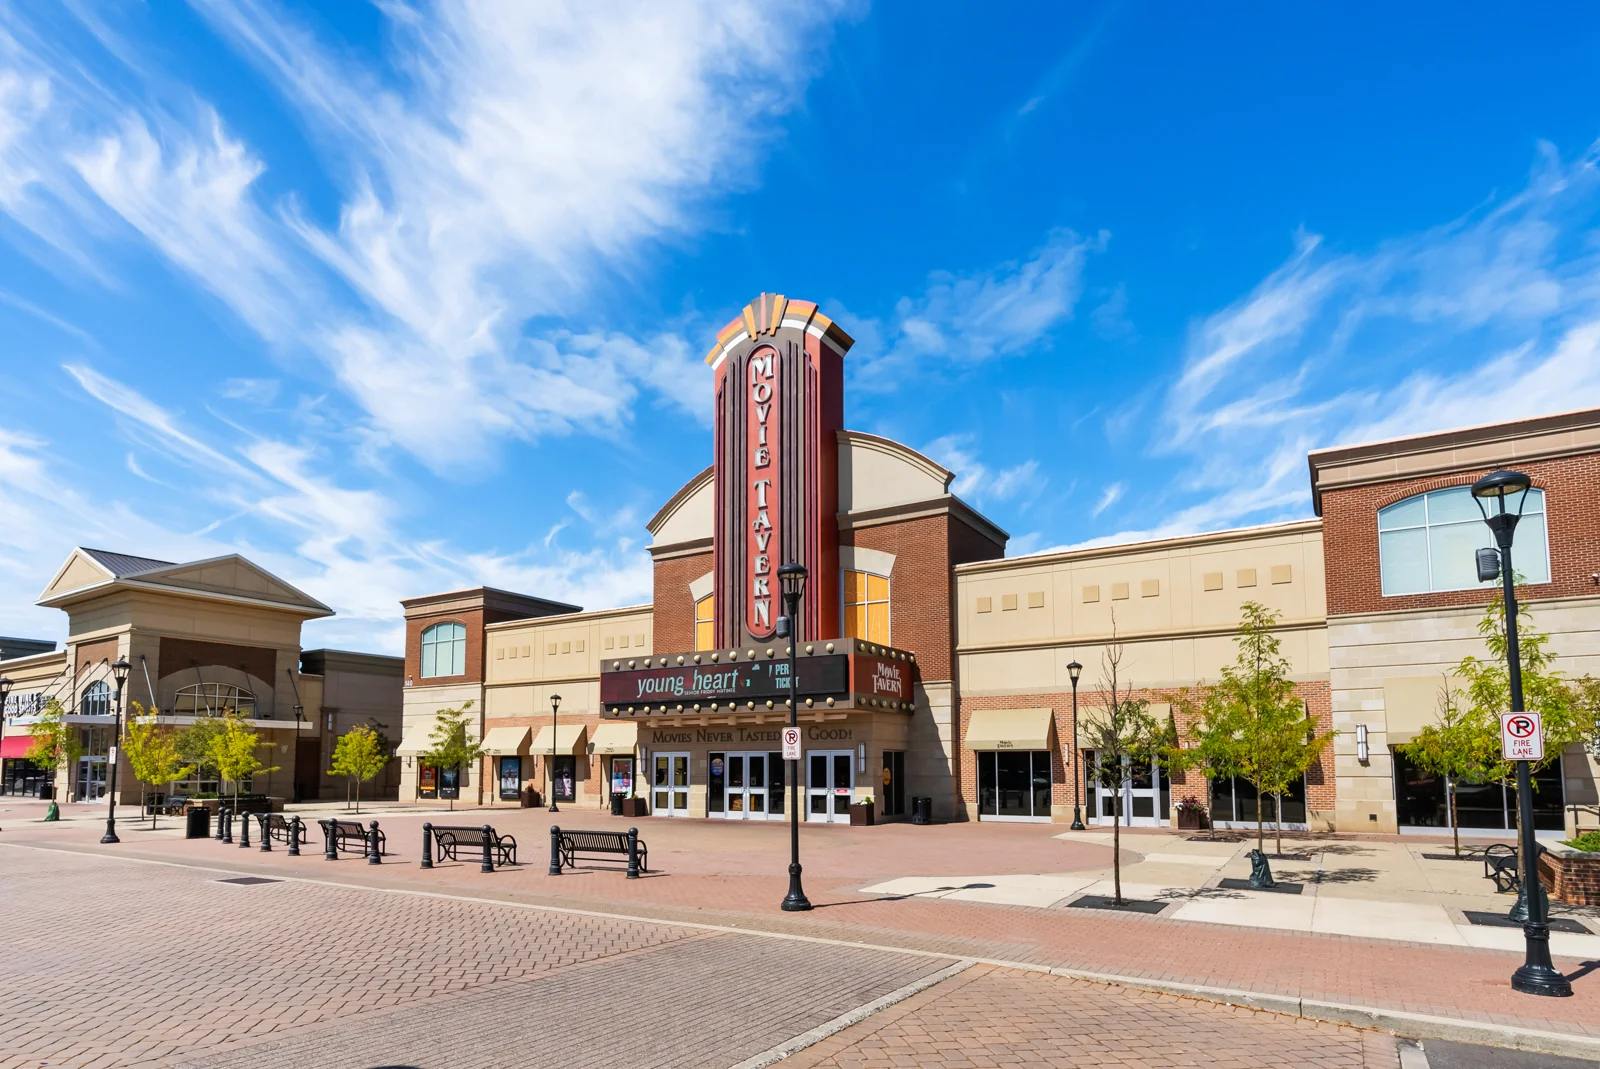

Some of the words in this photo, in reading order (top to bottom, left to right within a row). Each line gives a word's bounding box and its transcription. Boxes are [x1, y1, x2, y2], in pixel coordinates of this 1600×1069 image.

[752, 354, 775, 470] MOVIE
[752, 478, 773, 629] TAVERN
[775, 664, 789, 675] PER
[877, 662, 900, 679] MOVIE
[637, 676, 684, 698] young
[692, 669, 738, 690] heart
[775, 676, 799, 688] TICKT
[872, 675, 902, 697] TAVERN
[652, 731, 692, 743] MOVIES
[696, 729, 733, 743] NEVER
[737, 728, 782, 742] TASTED
[808, 725, 852, 740] GOOD!
